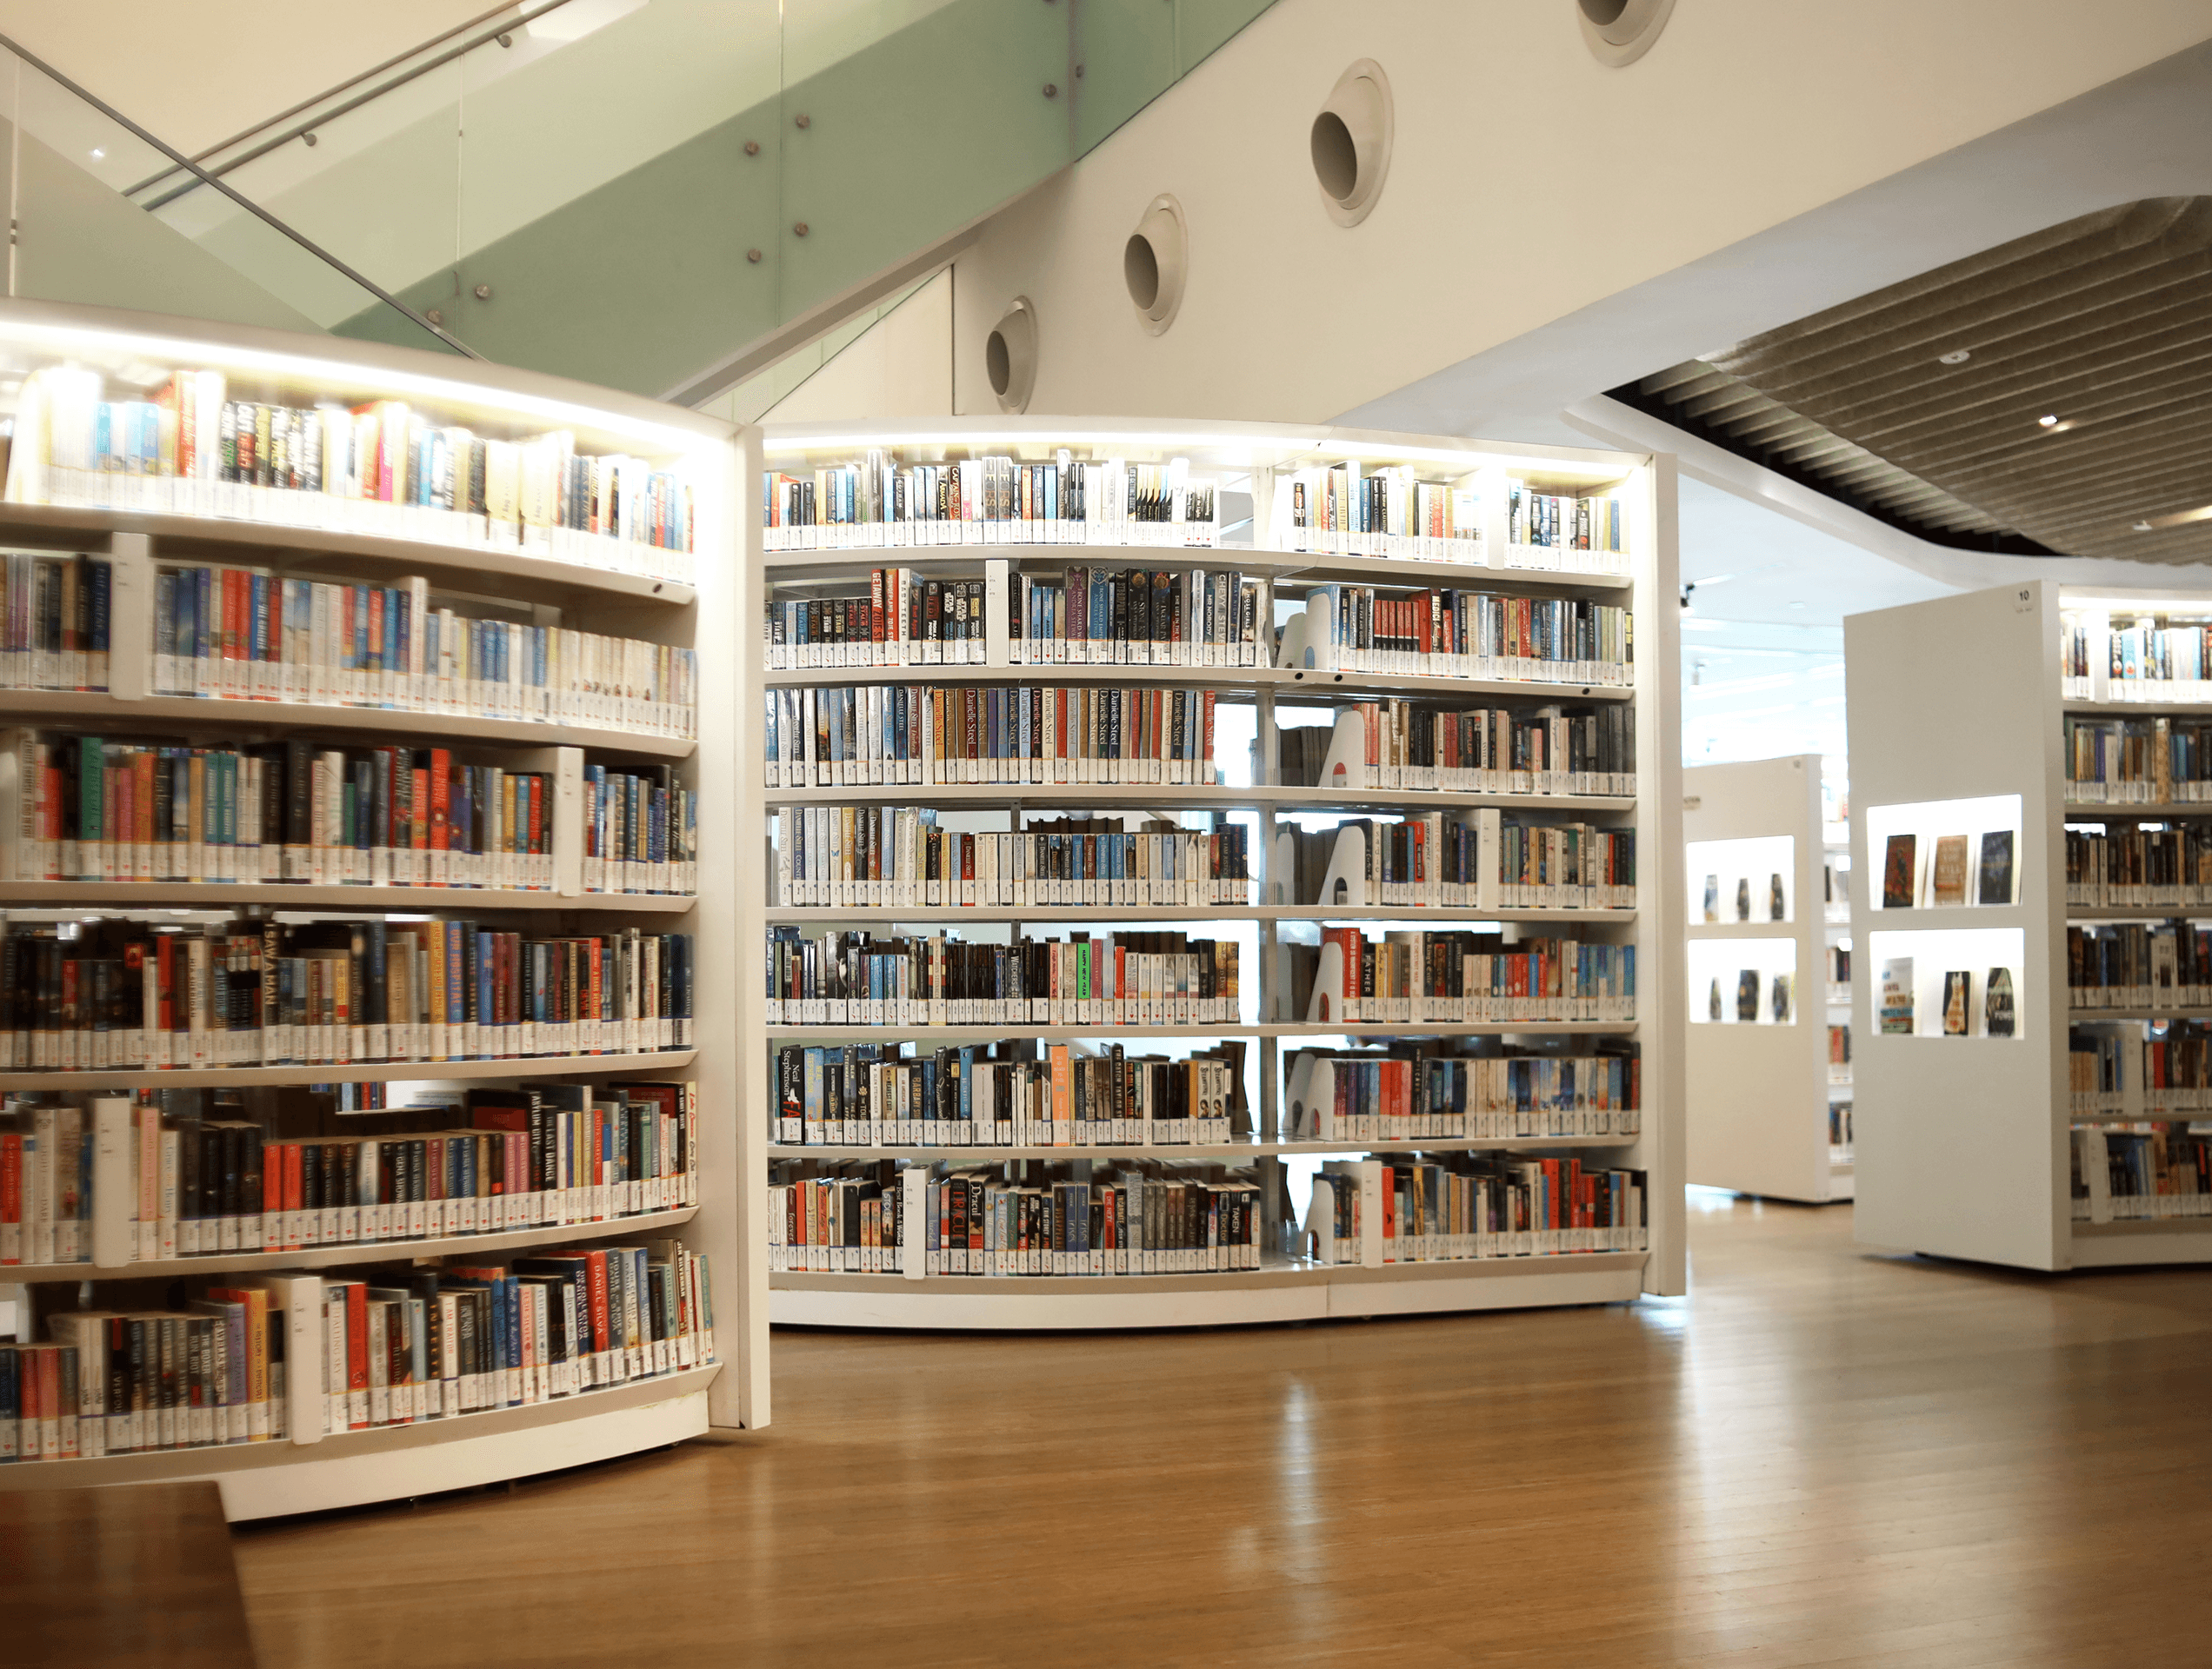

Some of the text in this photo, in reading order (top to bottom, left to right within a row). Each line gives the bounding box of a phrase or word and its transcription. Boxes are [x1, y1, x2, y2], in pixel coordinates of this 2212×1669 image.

[872, 572, 883, 627] GETAWAY ZOJE
[1206, 594, 1212, 605] MR
[2019, 590, 2029, 601] 10
[967, 690, 976, 745] Danielle Steel
[1009, 690, 1017, 721] Danielle
[1044, 690, 1054, 744] Danielle Steel
[1099, 690, 1109, 745] Danielle Steel
[1173, 692, 1183, 746] Danielle Steel
[795, 835, 803, 851] STEEL
[857, 833, 866, 847] STEEL
[264, 931, 276, 959] SAW
[1010, 955, 1020, 986] WATCHERS
[264, 975, 276, 1005] MAN
[783, 1050, 791, 1095] Stephenson
[530, 1095, 541, 1146] ASYLUM CITY
[545, 1128, 555, 1150] LAST
[544, 1153, 556, 1182] DANCE
[953, 1192, 965, 1240] DRACUL
[970, 1185, 982, 1216] Dracul
[593, 1265, 602, 1303] DANIEL
